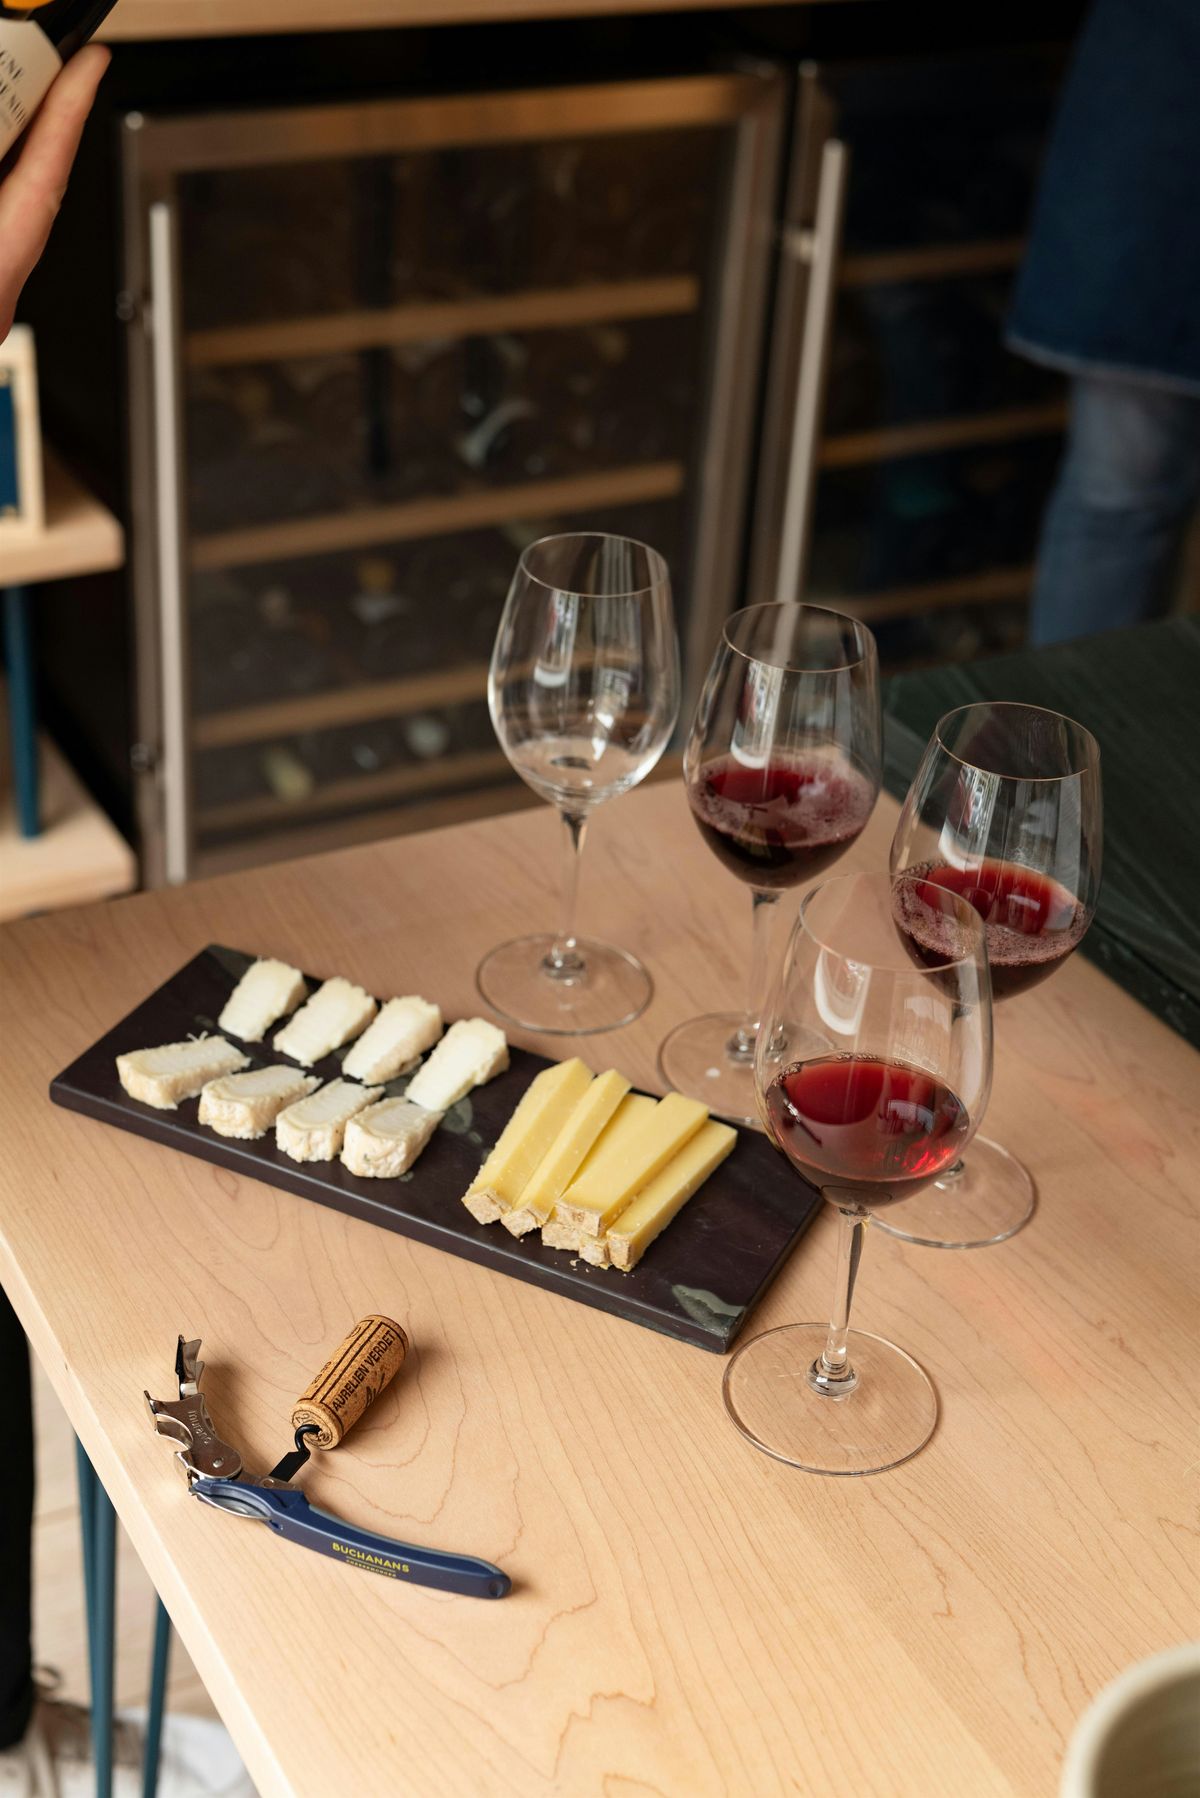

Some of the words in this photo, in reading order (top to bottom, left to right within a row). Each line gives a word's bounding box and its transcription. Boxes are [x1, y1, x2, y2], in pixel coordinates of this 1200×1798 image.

[331, 1363, 370, 1412] AURELIEN
[364, 1330, 396, 1368] VERDET
[332, 1542, 410, 1572] BUCHANANS
